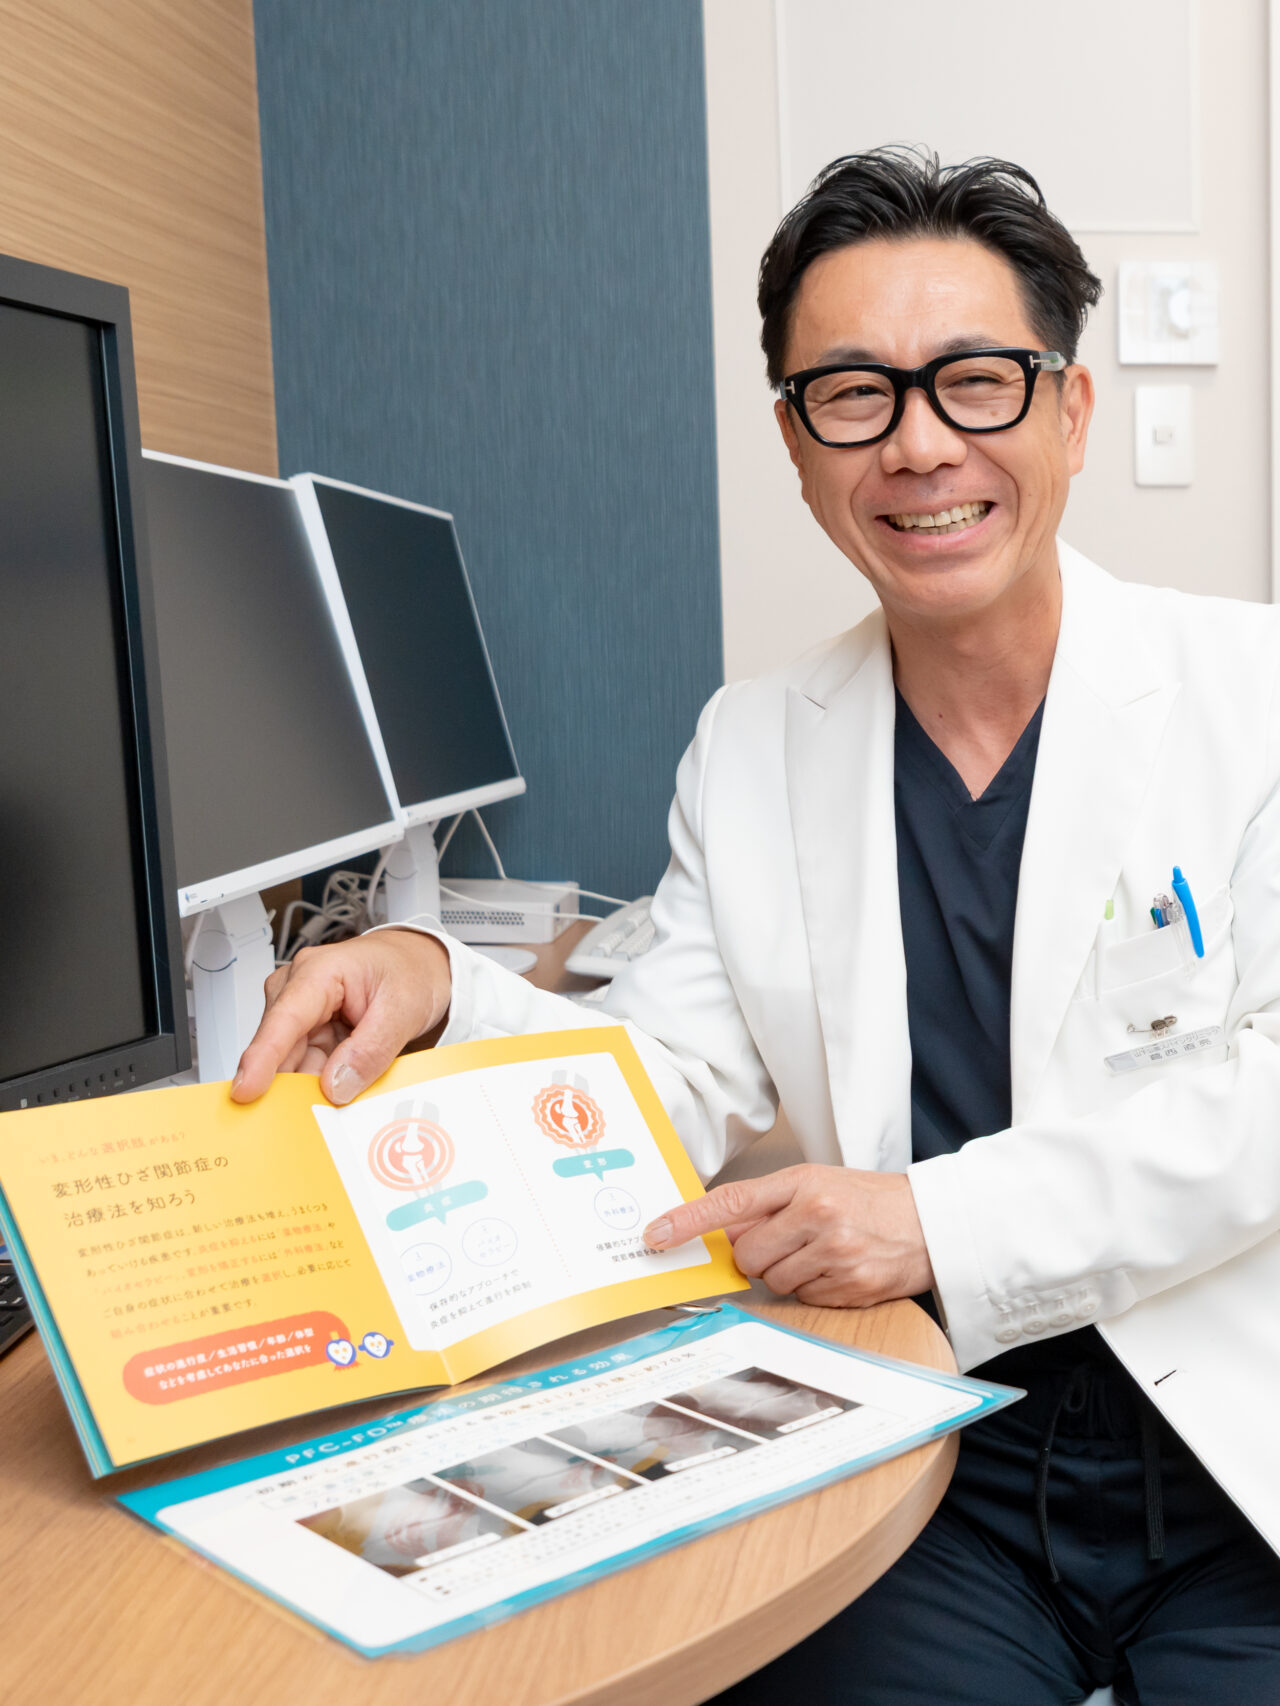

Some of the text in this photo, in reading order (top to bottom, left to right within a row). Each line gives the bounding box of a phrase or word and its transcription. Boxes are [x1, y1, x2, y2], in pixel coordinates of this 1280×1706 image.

[51, 1155, 229, 1199] 変形性ひざ関節症の
[63, 1189, 196, 1229] 治療法を知ろう
